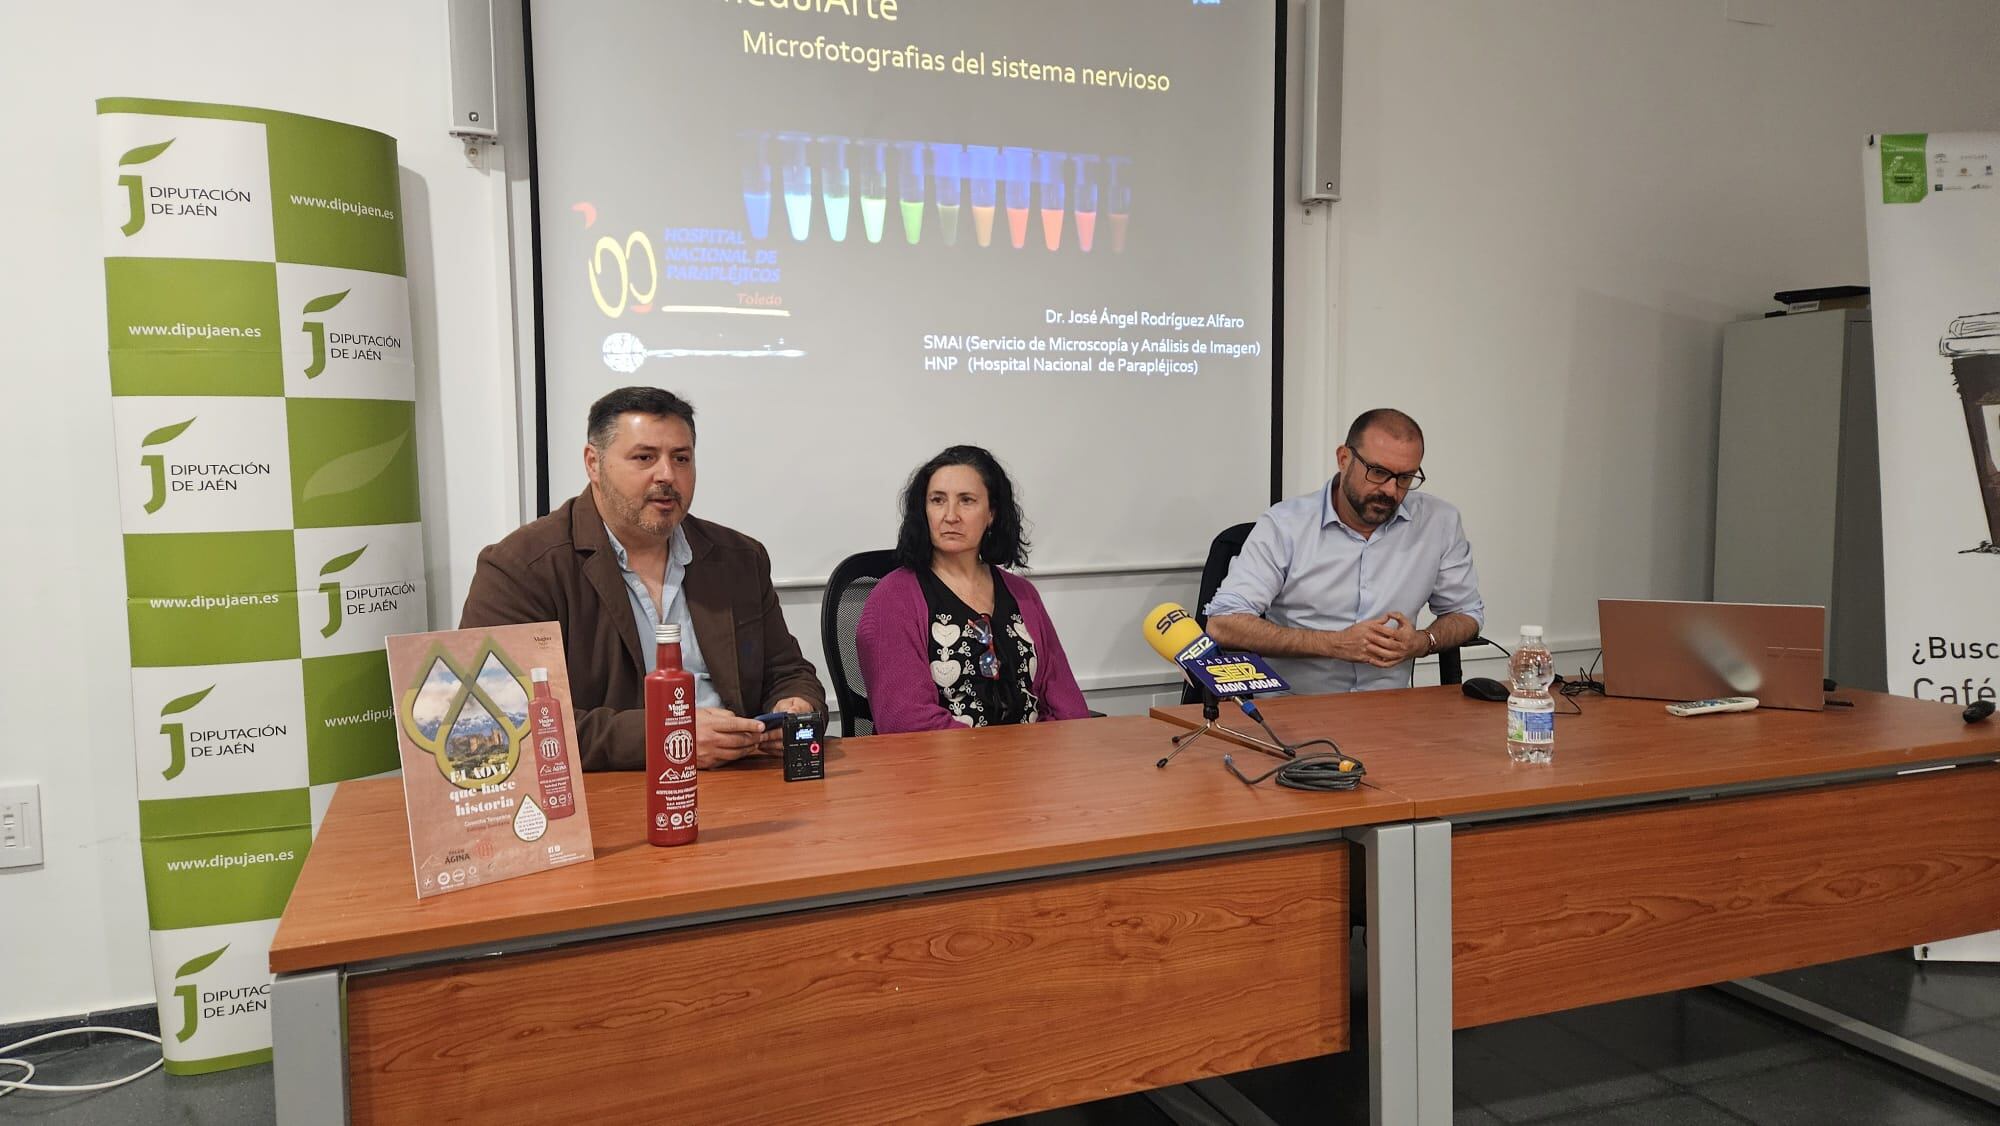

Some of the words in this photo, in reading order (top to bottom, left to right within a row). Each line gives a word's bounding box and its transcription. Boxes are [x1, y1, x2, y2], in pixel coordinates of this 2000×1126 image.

[743, 30, 945, 72] Microfotografias
[951, 50, 984, 76] del
[991, 56, 1076, 83] sistema
[1082, 68, 1170, 92] nervioso
[149, 186, 251, 202] DIPUTACIÓN
[151, 203, 173, 215] DE
[177, 203, 218, 217] JAÉN
[290, 193, 394, 220] www.dipujaen.es
[664, 227, 744, 244] HOSPITAL
[665, 247, 750, 264] NACIONAL
[755, 249, 777, 264] DE
[737, 292, 782, 305] Toledo
[1045, 309, 1065, 324] Dr.
[1068, 309, 1097, 324] José
[1099, 307, 1138, 328] Ángel
[1141, 312, 1205, 330] Rodríguez
[1206, 314, 1244, 328] Alfaro
[129, 323, 261, 339] www.dipujaen.es
[329, 332, 401, 348] DIPUTACIÓN
[923, 335, 962, 350] SMAI
[965, 335, 1026, 352] (Servicio
[1029, 336, 1046, 350] de
[1049, 337, 1128, 355] Microscopía
[1131, 341, 1139, 355] y
[1141, 338, 1189, 353] Análisis
[1191, 340, 1207, 353] de
[1210, 341, 1261, 358] Imagen)
[331, 348, 349, 359] DE
[353, 348, 382, 361] JAÉN
[924, 356, 958, 371] HNP
[968, 357, 1030, 375] (Hospital
[1033, 357, 1092, 371] Nacional
[1099, 358, 1115, 372] de
[1118, 358, 1199, 377] Parapléjicos)
[170, 461, 270, 476] DIPUTACIÓN
[172, 480, 194, 491] DE
[197, 478, 237, 491] JAÉN
[346, 582, 415, 600] DIPUTACIÓN
[150, 593, 279, 609] www.dipujaen.es
[347, 603, 365, 615] DE
[368, 599, 398, 613] JAÉN
[1197, 655, 1250, 666] CADENA
[1206, 662, 1267, 683] SER
[1215, 680, 1248, 694] RADIO
[1248, 678, 1282, 690] JODAR
[324, 706, 395, 727] www.dipuj
[190, 724, 287, 742] DIPUTACIÓN
[191, 745, 213, 757] DE
[216, 741, 254, 756] JAÉN
[449, 788, 477, 803] que
[481, 780, 516, 795] hace
[455, 796, 514, 816] historia
[167, 849, 294, 871] www.dipujaen.es
[204, 1006, 225, 1019] DE
[228, 1000, 267, 1015] JAÉN
